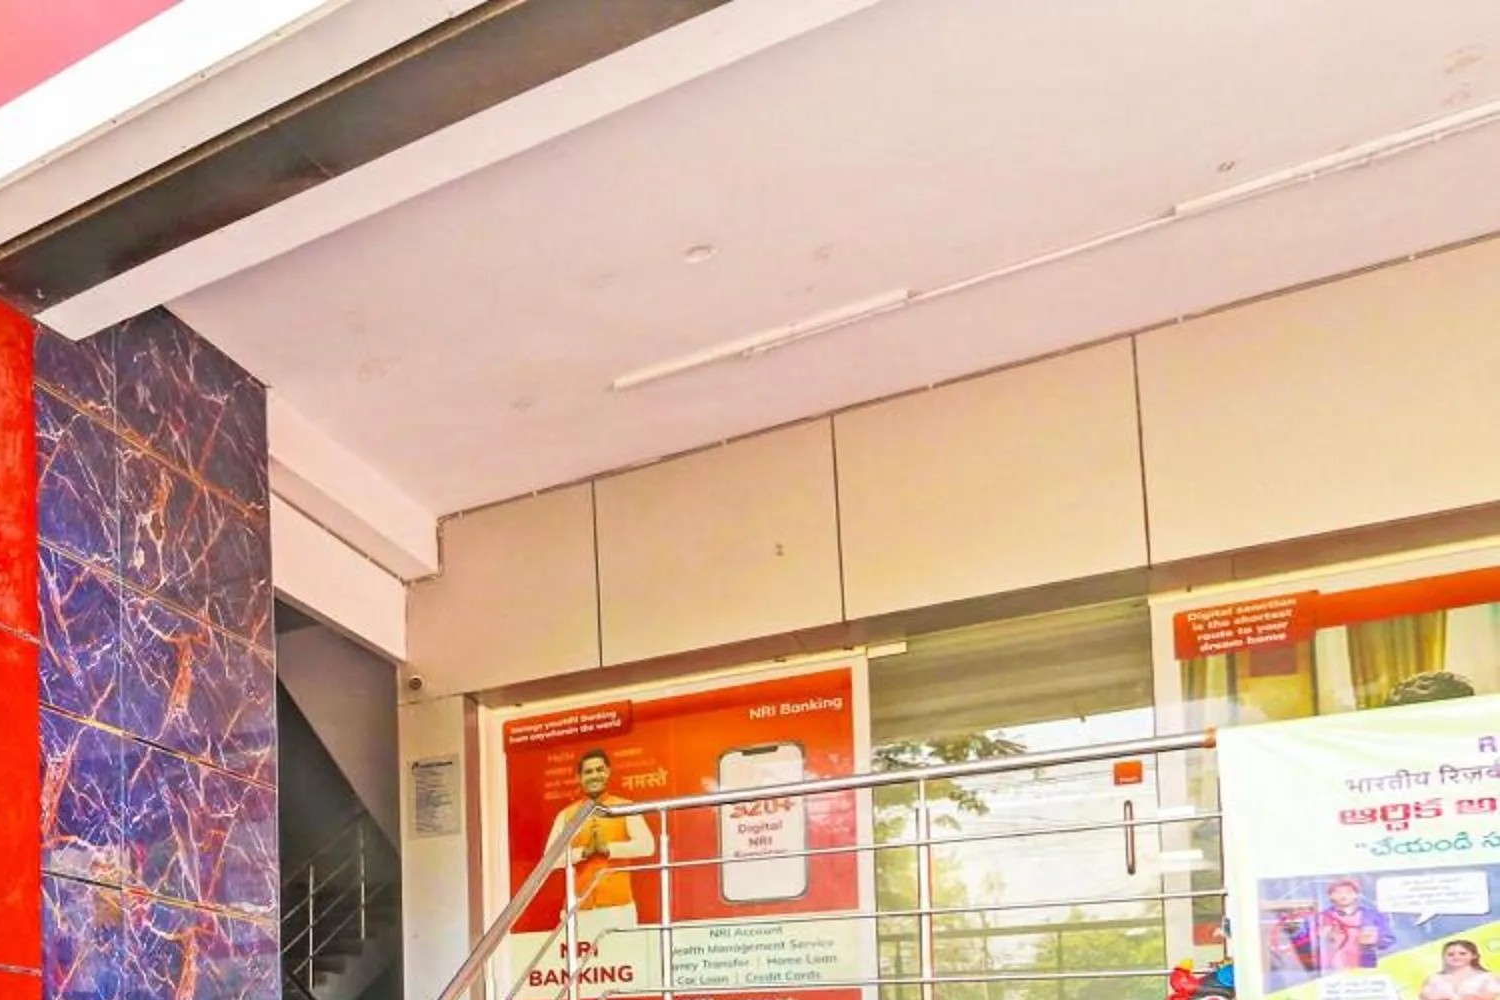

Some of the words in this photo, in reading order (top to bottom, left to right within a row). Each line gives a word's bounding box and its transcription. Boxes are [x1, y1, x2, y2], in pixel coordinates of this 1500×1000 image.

[1187, 607, 1233, 622] Digital
[1197, 629, 1234, 642] route
[1237, 626, 1253, 636] to
[1256, 621, 1289, 634] your
[1207, 619, 1231, 630] the
[1199, 639, 1244, 653] dream
[1246, 632, 1288, 645] home
[748, 705, 777, 721] NRI
[779, 697, 844, 716] Banking
[622, 767, 669, 791] नमस्ते
[1346, 768, 1431, 793] भारतीय
[737, 820, 783, 835] Digital
[748, 836, 773, 848] NRI
[709, 927, 732, 938] NRI
[734, 926, 784, 937] Account
[707, 940, 786, 955] Management
[701, 958, 750, 969] Transfer
[767, 956, 803, 967] Home
[806, 953, 838, 964] Loan
[529, 965, 634, 987] BANKING
[676, 975, 696, 985] Car
[700, 974, 729, 985] Loan
[745, 971, 782, 983] Credit
[784, 970, 821, 981] Cards
